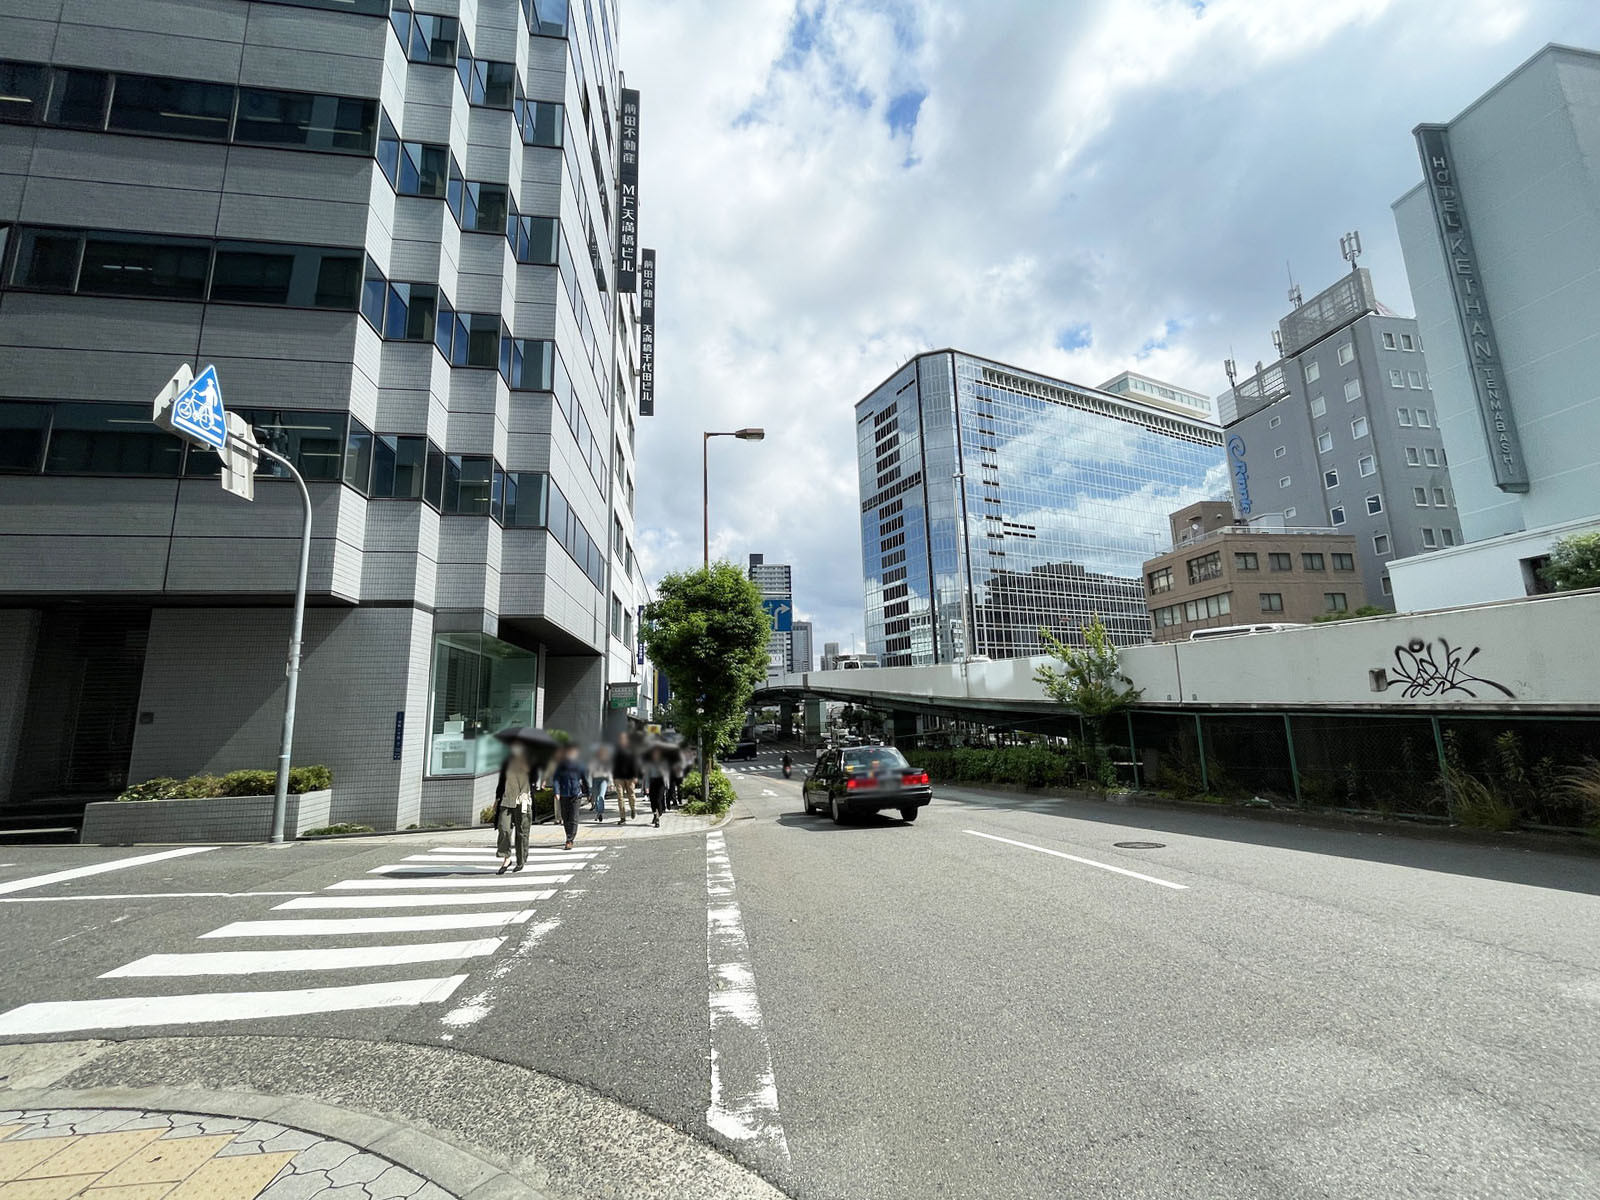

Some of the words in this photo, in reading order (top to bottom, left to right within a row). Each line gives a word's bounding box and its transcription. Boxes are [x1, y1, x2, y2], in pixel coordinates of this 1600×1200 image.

[622, 103, 637, 164] 前田不動産
[621, 183, 635, 272] MF天満橋ビル
[1432, 156, 1459, 228] HOTEL
[1451, 239, 1492, 359] KEIHAN
[1484, 368, 1513, 475] TENMABASHI
[642, 324, 653, 401] 天満橋千代田ビル
